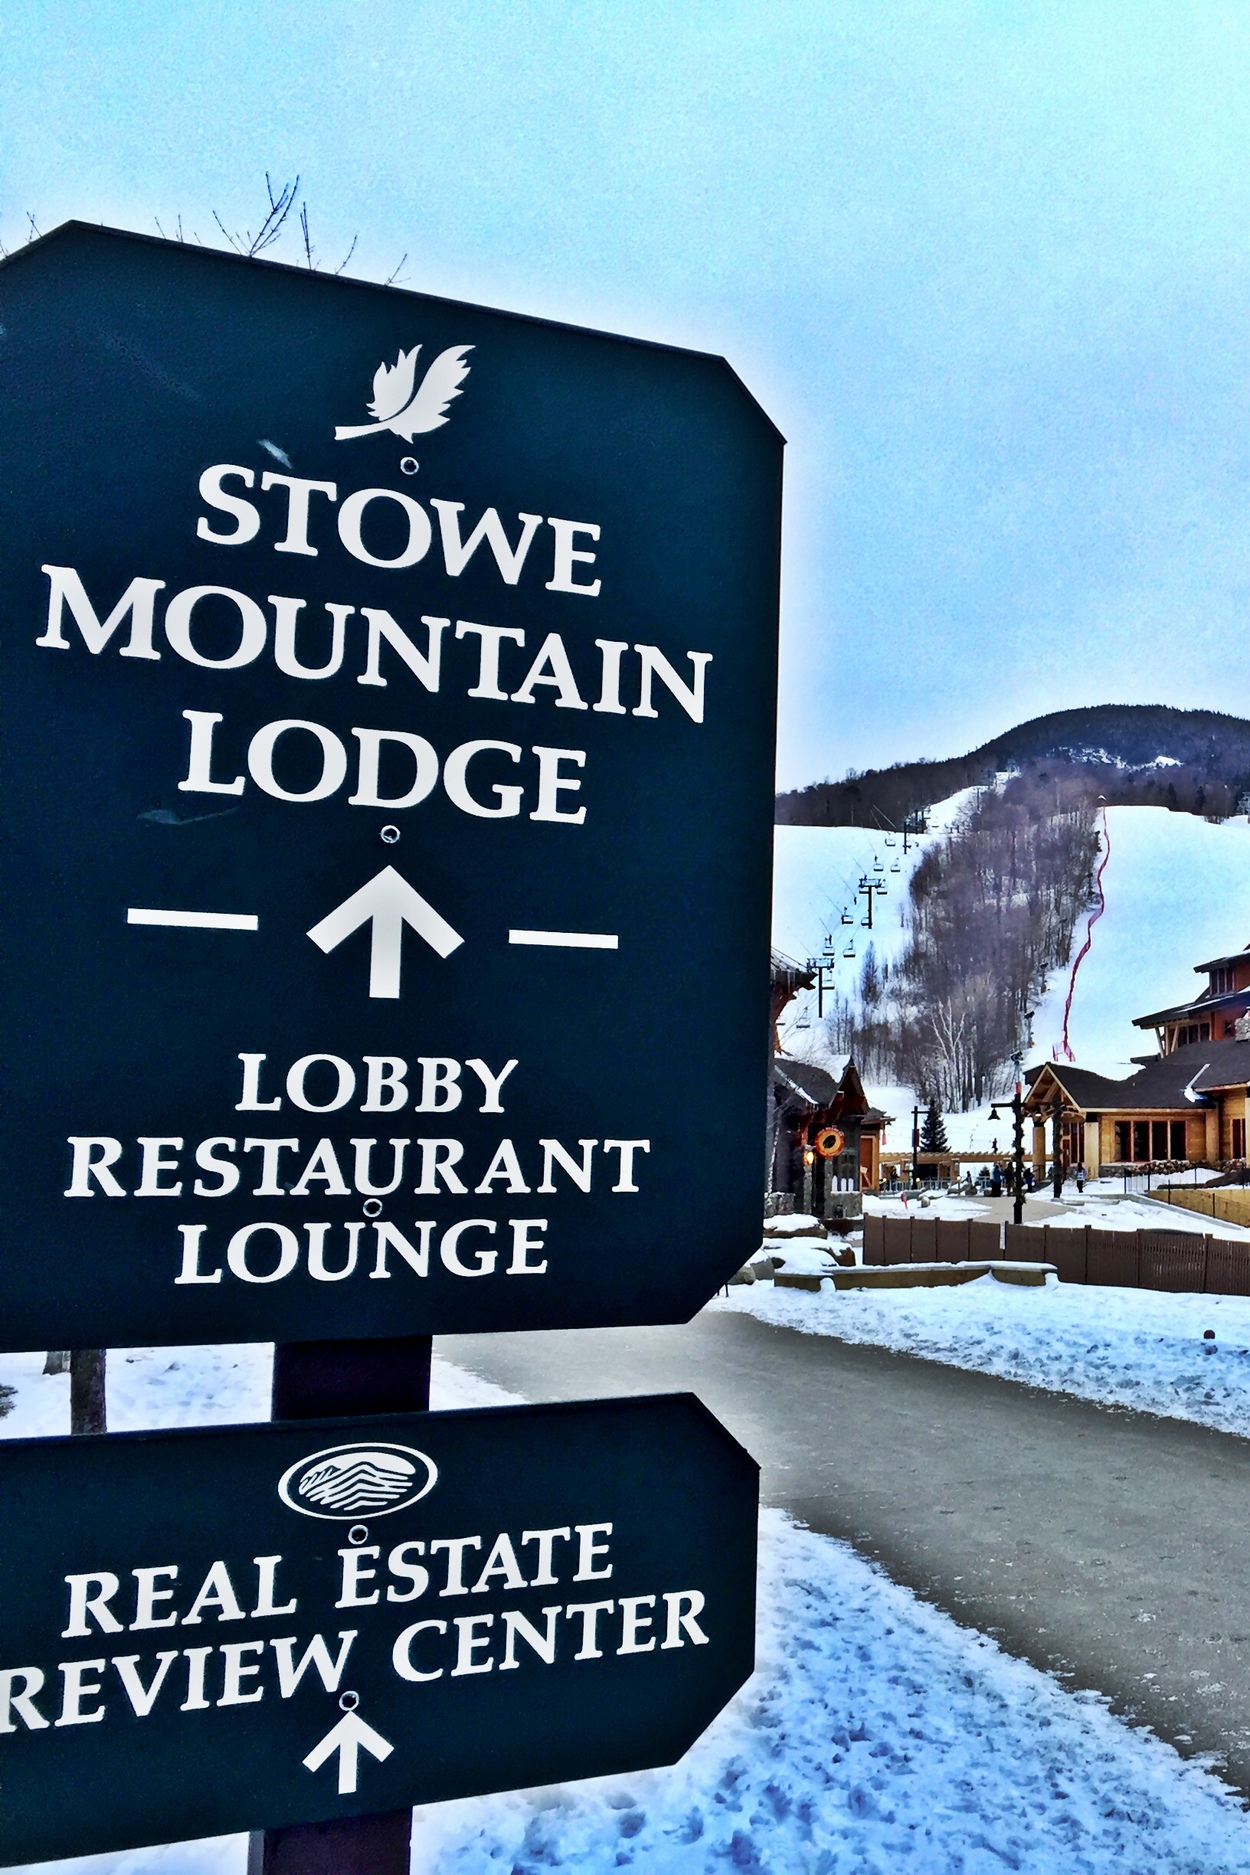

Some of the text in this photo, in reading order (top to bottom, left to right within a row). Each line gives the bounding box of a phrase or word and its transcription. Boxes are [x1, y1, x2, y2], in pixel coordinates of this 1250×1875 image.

[197, 464, 601, 596] STOWE
[36, 565, 713, 723] MOUNTAIN
[178, 710, 586, 824] LODGE
[235, 1053, 518, 1113] LOBBY
[64, 1137, 650, 1197] RESTAURANT
[175, 1219, 547, 1284] LOUNGE
[62, 1523, 612, 1637] REAL ESTATE
[393, 1590, 709, 1681] CENTER
